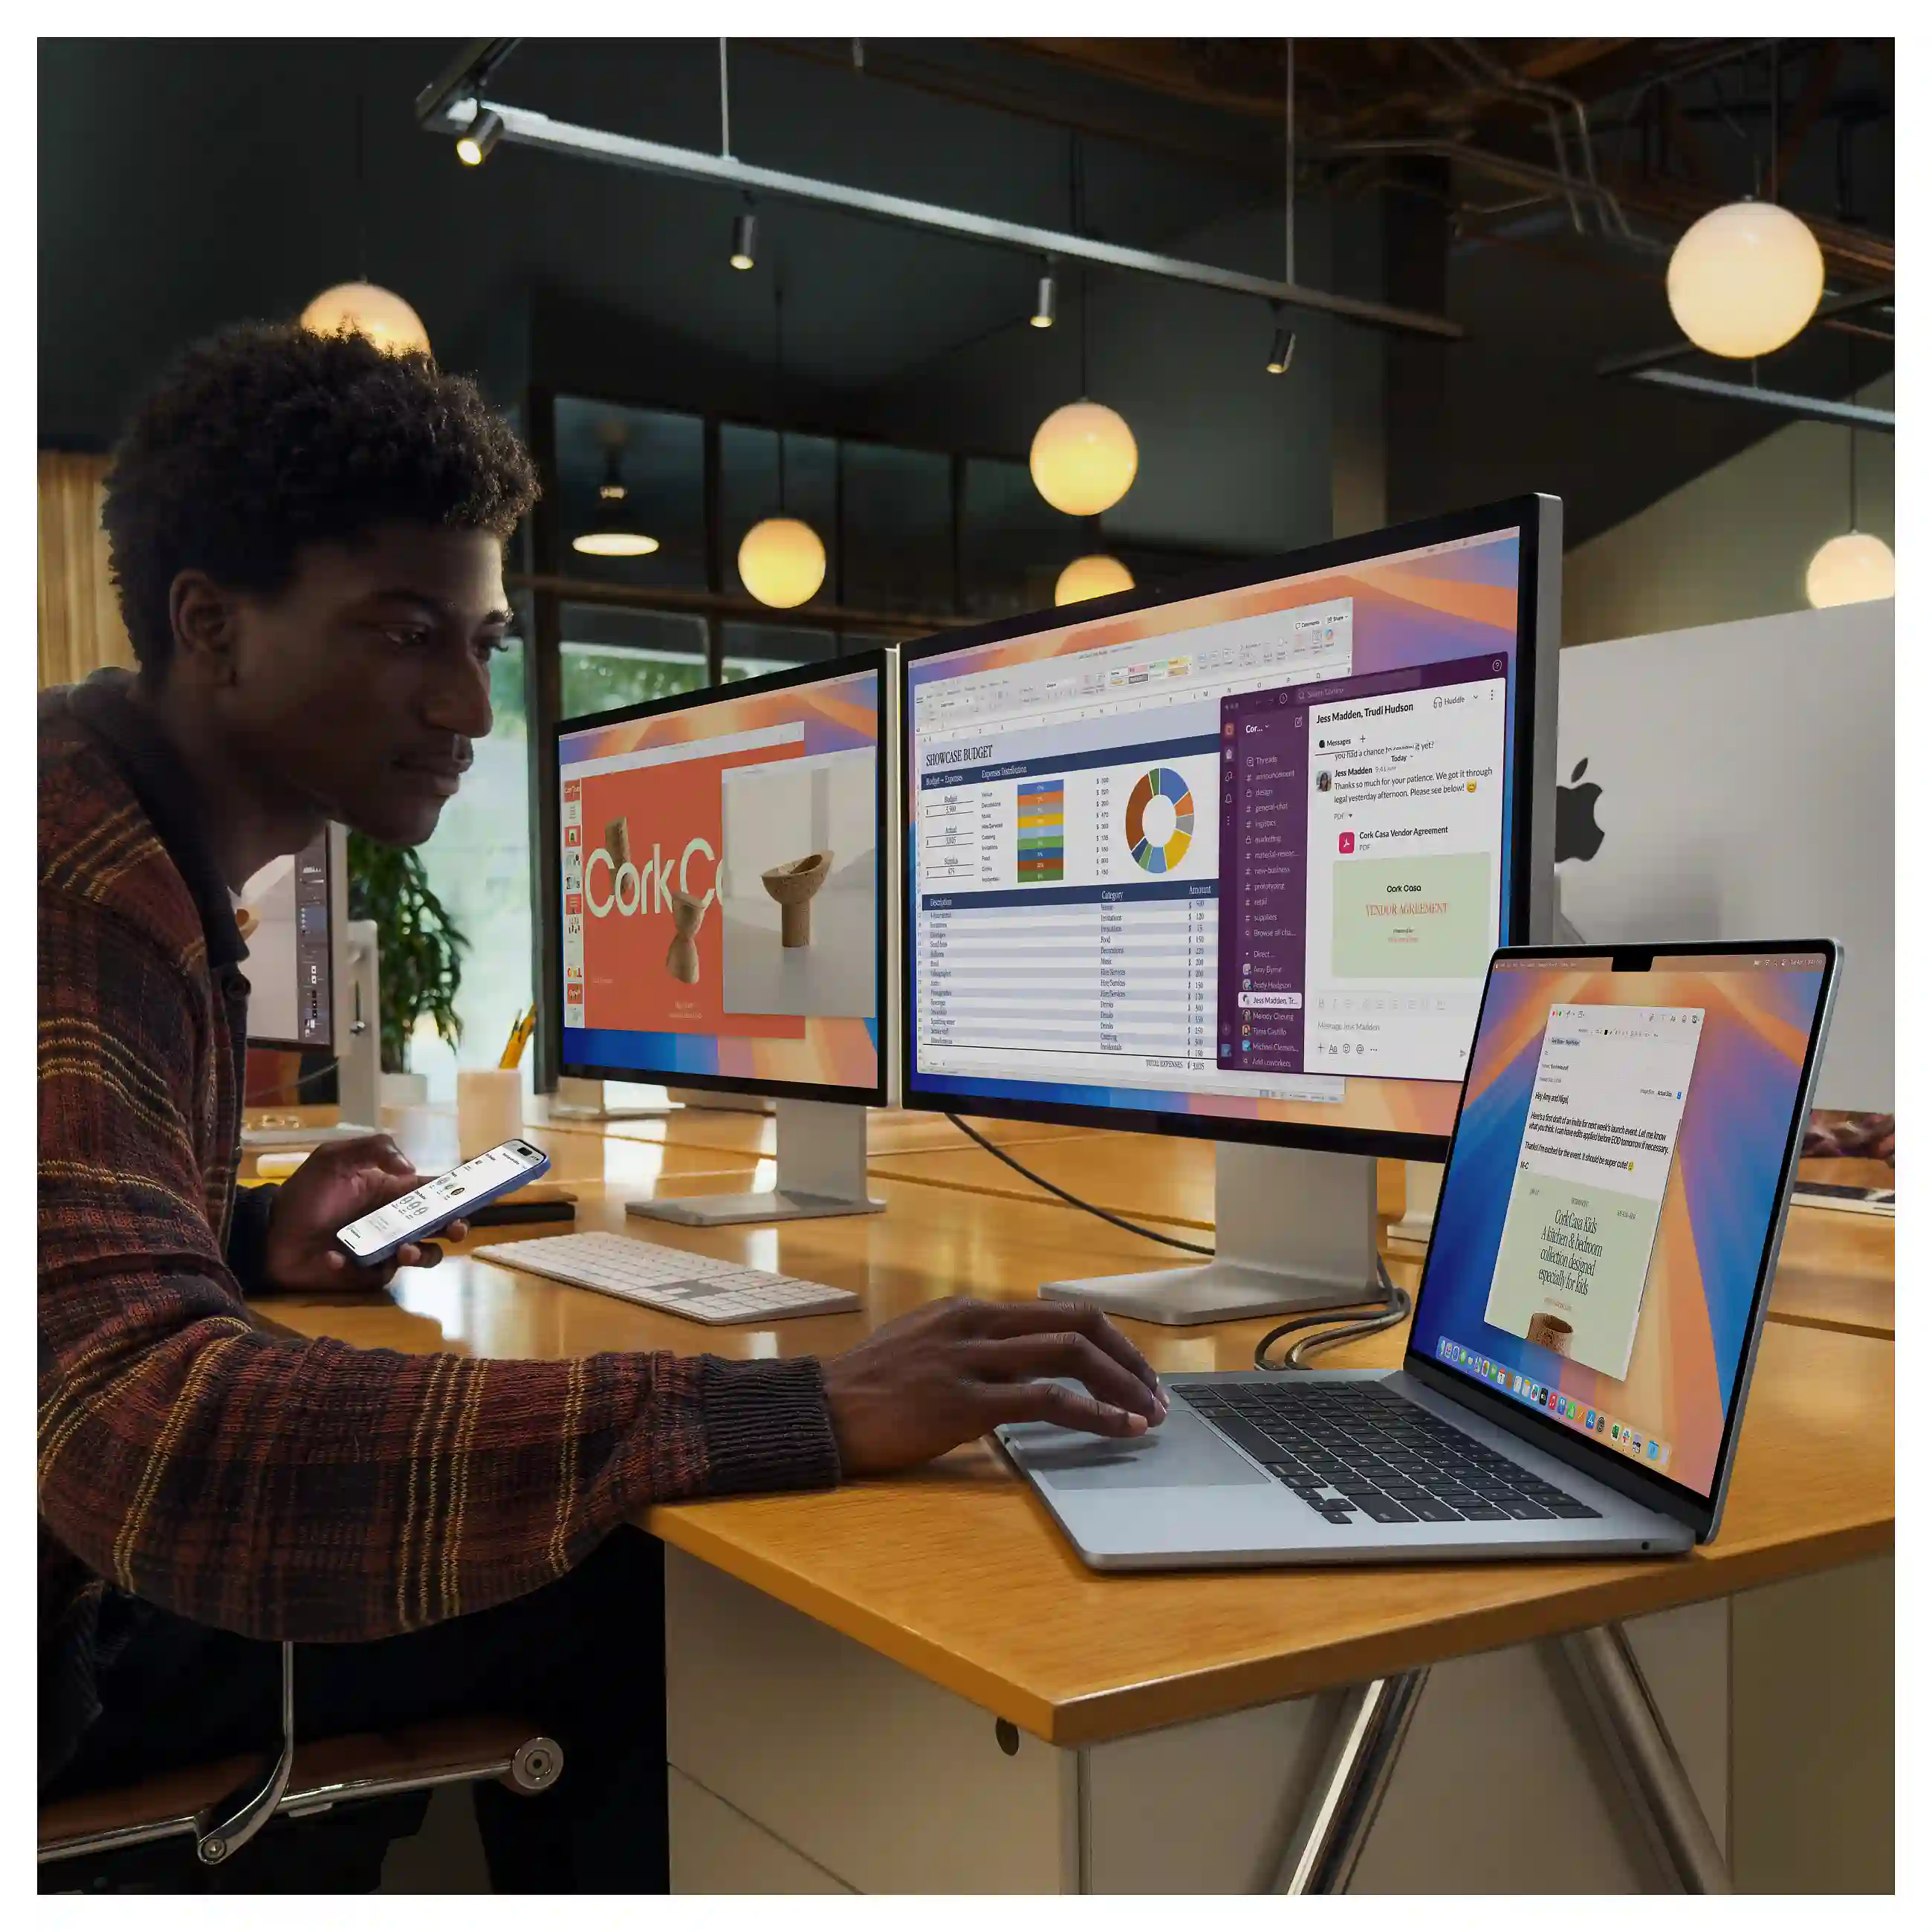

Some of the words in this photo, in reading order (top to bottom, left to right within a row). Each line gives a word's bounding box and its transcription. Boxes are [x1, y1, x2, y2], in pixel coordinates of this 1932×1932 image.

[1445, 696, 1465, 705] Huddle
[1317, 715, 1330, 724] Jess
[1332, 710, 1363, 721] Madden,
[1364, 706, 1383, 717] Trudi
[1384, 704, 1413, 715] Hudson
[1326, 739, 1351, 747] Messages
[926, 748, 962, 767] SHOWCASE
[963, 745, 993, 761] BUDGET
[1335, 752, 1346, 761] you
[1364, 748, 1384, 756] chance
[1422, 742, 1433, 751] yet?
[1256, 756, 1277, 764] Threads
[982, 768, 1000, 779] Expenses
[1002, 765, 1027, 776] Distribution
[1335, 769, 1346, 777] Jess
[1348, 767, 1372, 776] Madden
[1391, 777, 1407, 786] your
[1407, 774, 1434, 784] patience.
[1448, 771, 1459, 780] got
[1466, 767, 1492, 777] through
[1255, 788, 1273, 797] design
[1335, 795, 1347, 804] legal
[1349, 792, 1376, 803] yesterday
[1378, 791, 1408, 799] afternoon.
[1410, 786, 1430, 796] Please
[1443, 783, 1465, 793] below!
[1255, 803, 1288, 814] general-chat
[1390, 829, 1413, 837] Vendor
[1413, 826, 1448, 836] Agreement
[1254, 866, 1290, 875] new-business
[584, 843, 676, 917] Cork
[1102, 891, 1124, 901] Category
[1189, 886, 1211, 894] Amount
[1254, 898, 1268, 906] retail
[1366, 904, 1397, 917] VENDOR
[1398, 902, 1449, 915] AGREEMENT
[1254, 913, 1277, 922] suppliers
[1254, 981, 1266, 989] Andy
[1254, 996, 1264, 1005] Jess
[1535, 1092, 1543, 1101] Hey
[1543, 1092, 1551, 1102] Amy
[1559, 1095, 1569, 1105] Nigel,
[1531, 1112, 1543, 1120] Here's
[1553, 1115, 1562, 1124] draft
[1572, 1118, 1581, 1127] invite
[1597, 1124, 1610, 1132] week's
[1611, 1124, 1624, 1134] launch
[1625, 1127, 1638, 1136] event.
[1653, 1130, 1666, 1141] know
[1564, 1128, 1573, 1137] have
[1573, 1129, 1583, 1138] edits
[1583, 1132, 1598, 1141] applied
[1598, 1132, 1611, 1143] before
[1611, 1136, 1621, 1144] EOD
[1621, 1138, 1641, 1148] tomorrow
[1641, 1141, 1645, 1149] if
[1645, 1144, 1669, 1155] necessary.
[1525, 1141, 1539, 1150] Thanks!
[1545, 1146, 1557, 1155] excited
[1586, 1153, 1599, 1164] should
[1599, 1156, 1604, 1164] be
[1605, 1158, 1617, 1167] super
[1617, 1161, 1628, 1169] cute!
[1520, 1161, 1529, 1170] M-C
[1555, 1209, 1569, 1227] Cork
[1569, 1213, 1583, 1231] Casa
[1583, 1216, 1598, 1234] Kids
[1541, 1225, 1546, 1240] A
[1546, 1225, 1568, 1246] kitchen
[1569, 1233, 1575, 1248] &
[1575, 1233, 1602, 1257] bedroom
[1540, 1245, 1568, 1267] collection
[1569, 1253, 1596, 1277] designed
[1538, 1268, 1566, 1291] especially
[1566, 1273, 1575, 1291] for
[1575, 1277, 1588, 1296] kids
